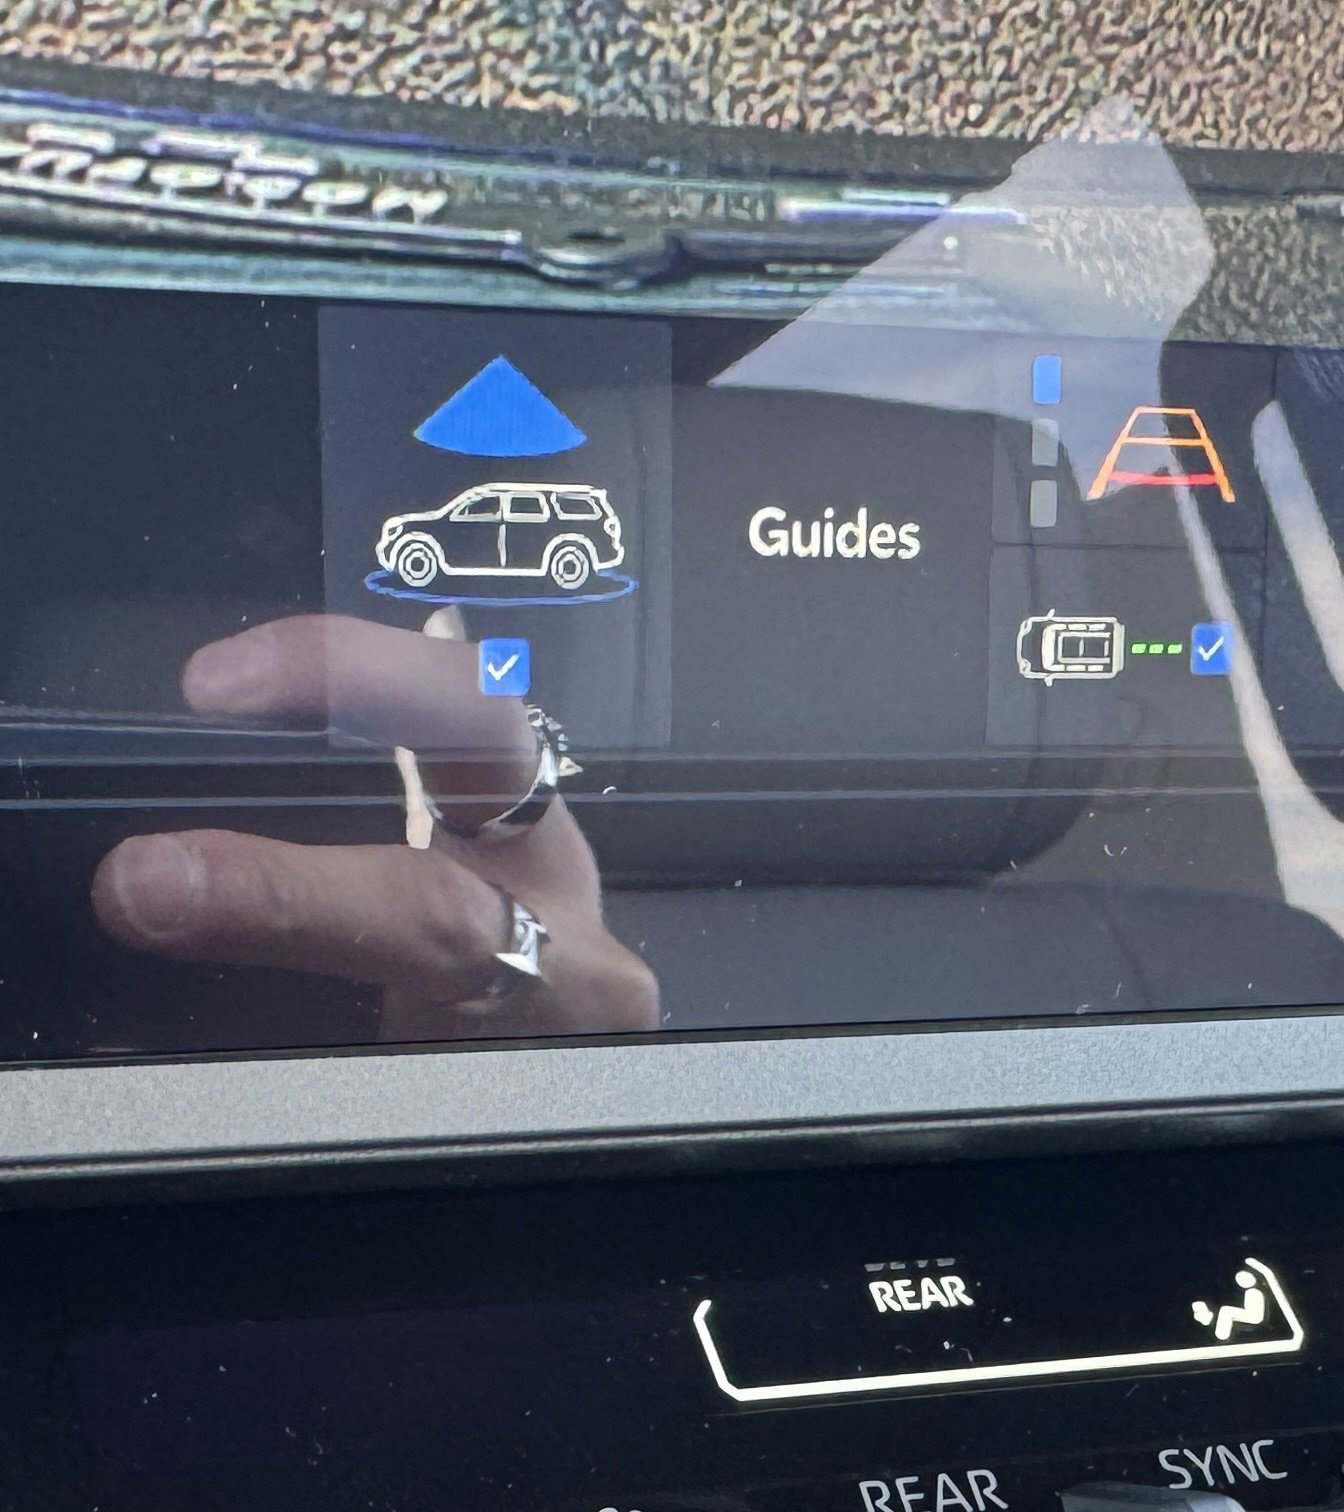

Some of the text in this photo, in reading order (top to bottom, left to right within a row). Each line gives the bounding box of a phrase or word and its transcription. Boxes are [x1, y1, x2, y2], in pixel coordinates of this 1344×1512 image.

[749, 506, 921, 561] Guides
[868, 1275, 975, 1313] REAR
[1158, 1439, 1288, 1490] SYNC
